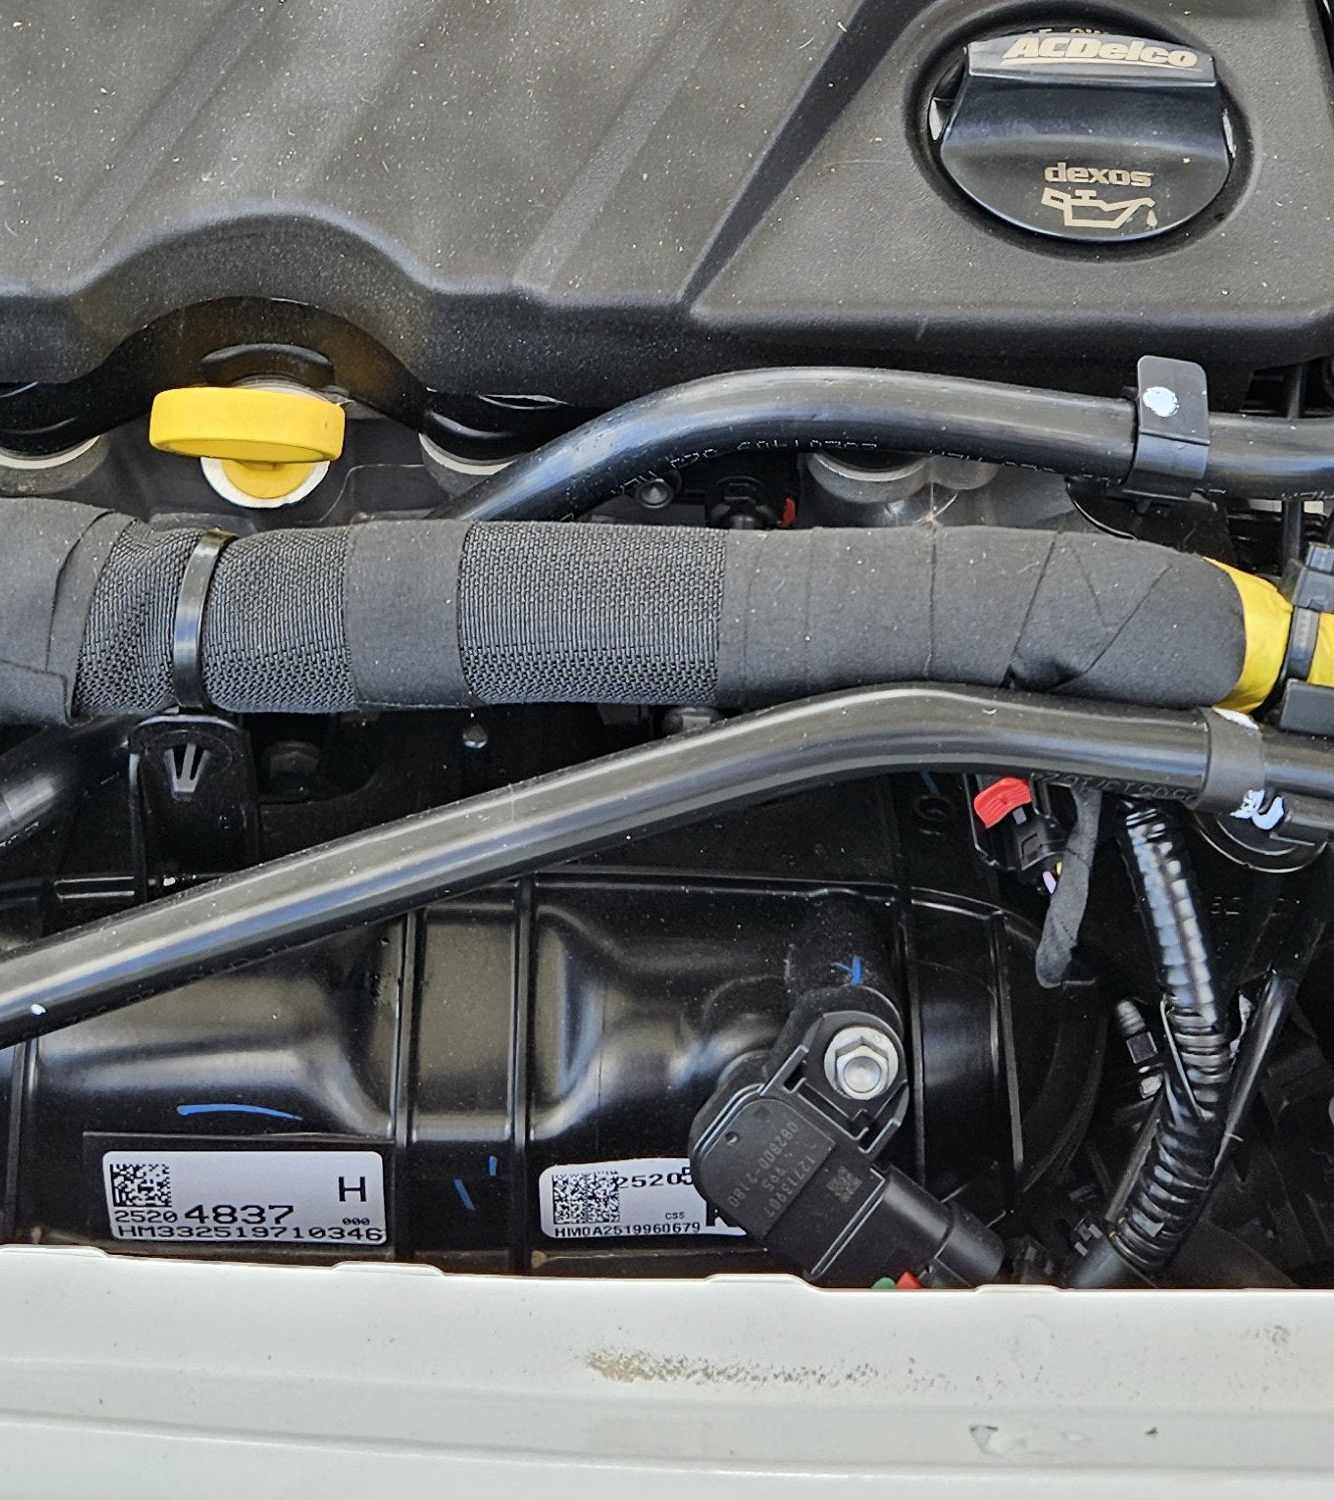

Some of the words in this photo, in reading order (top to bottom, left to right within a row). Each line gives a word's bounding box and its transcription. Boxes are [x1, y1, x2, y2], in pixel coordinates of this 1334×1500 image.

[1000, 36, 1201, 70] ACDelco
[1043, 161, 1155, 188] dexos
[338, 1176, 367, 1202] H
[115, 1209, 178, 1224] 2520
[184, 1204, 295, 1225] 4837
[342, 1217, 371, 1226] 000
[118, 1225, 386, 1241] HM332519710346
